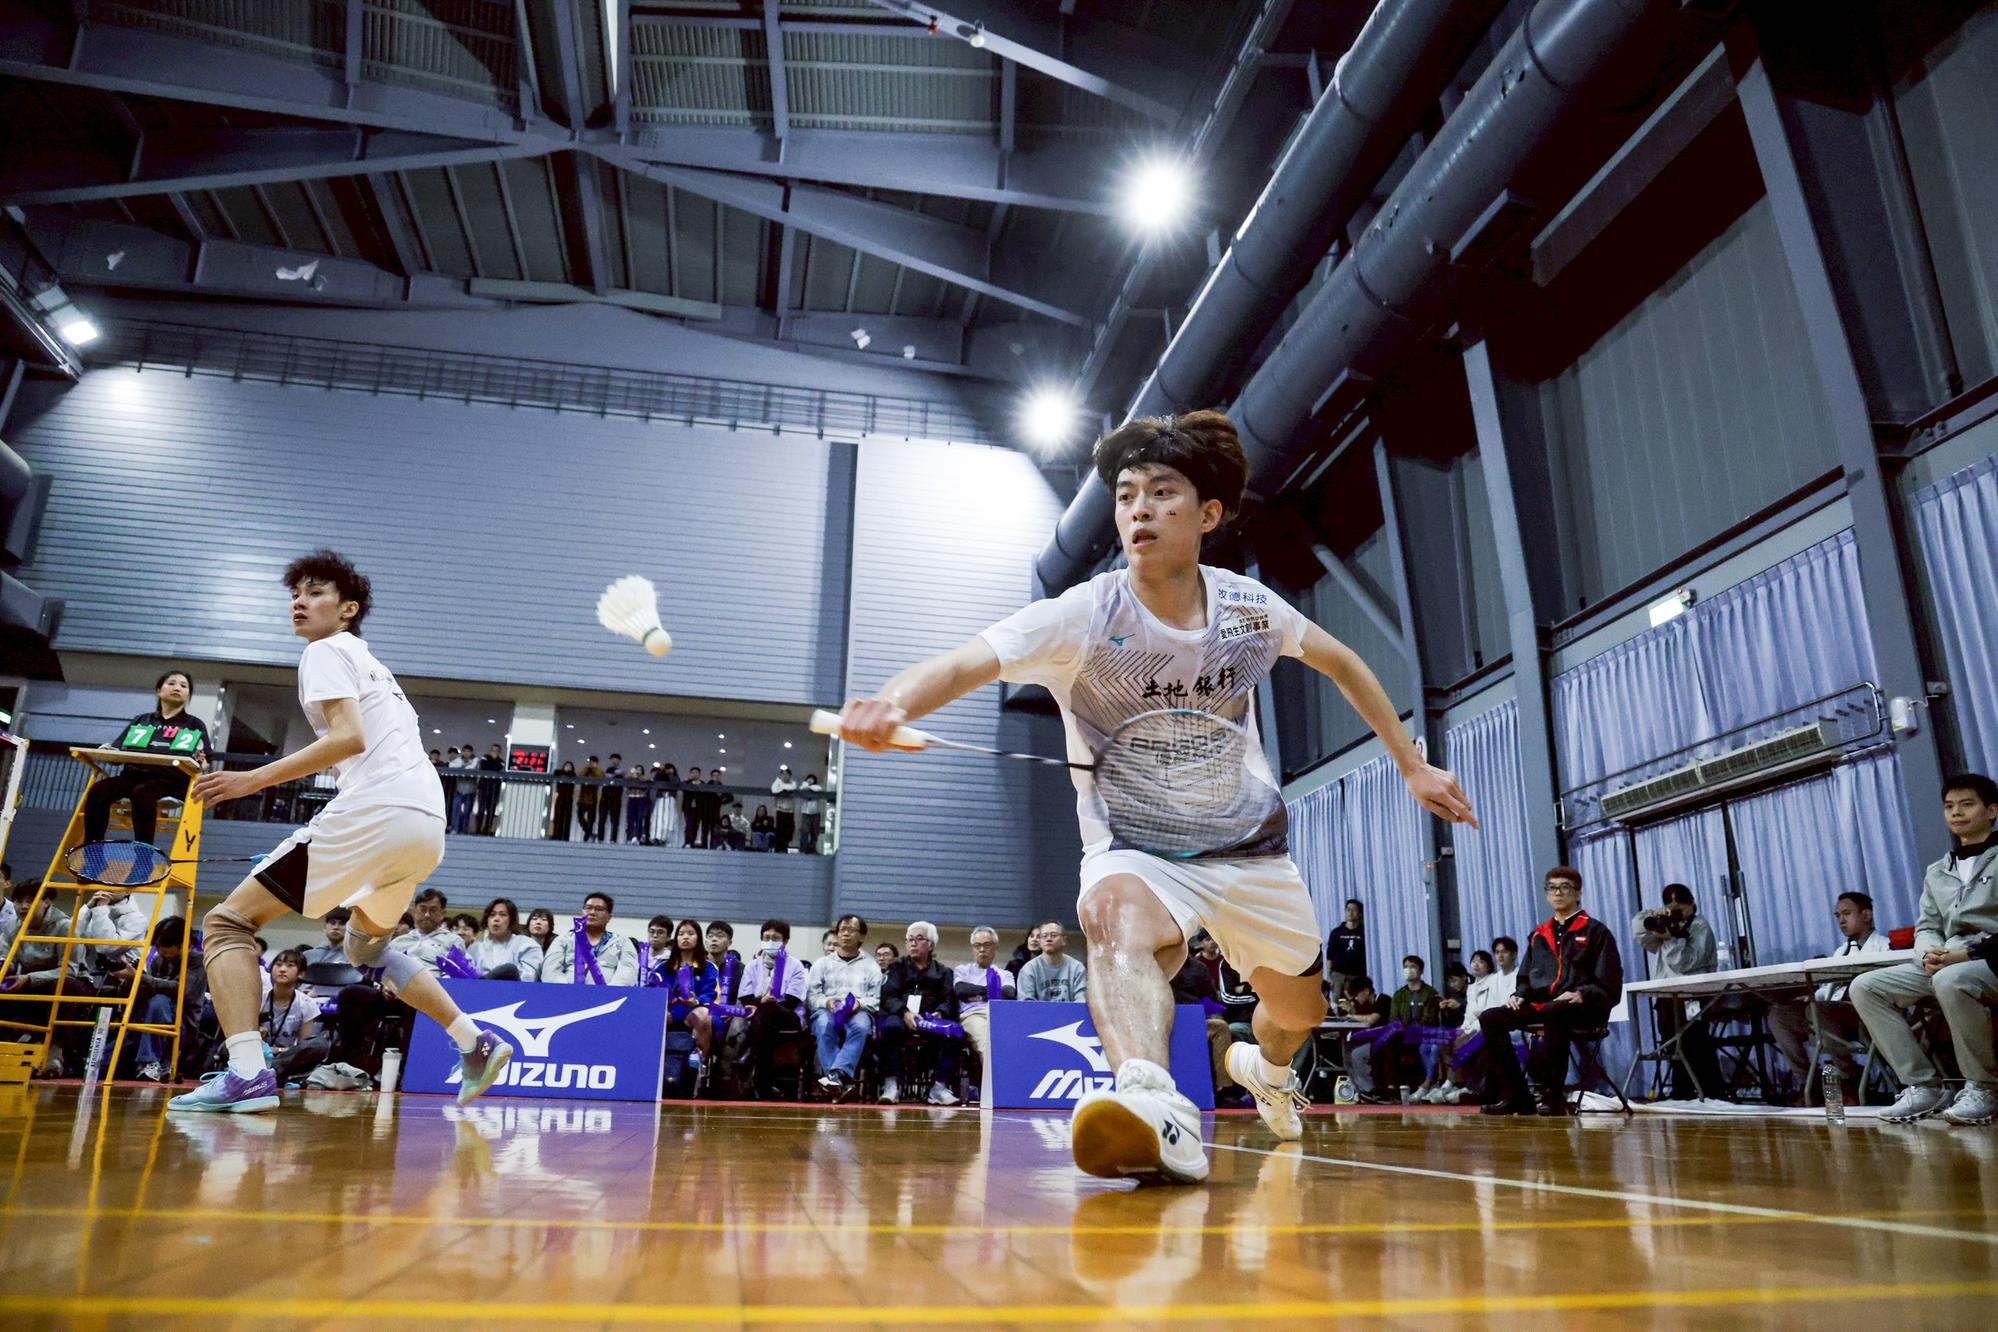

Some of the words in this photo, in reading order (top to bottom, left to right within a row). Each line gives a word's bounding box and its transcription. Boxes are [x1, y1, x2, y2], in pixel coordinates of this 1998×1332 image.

[1142, 666, 1236, 698] 土地銀行
[131, 729, 147, 744] 7
[175, 733, 193, 748] 2
[1029, 1069, 1115, 1099] MIZ
